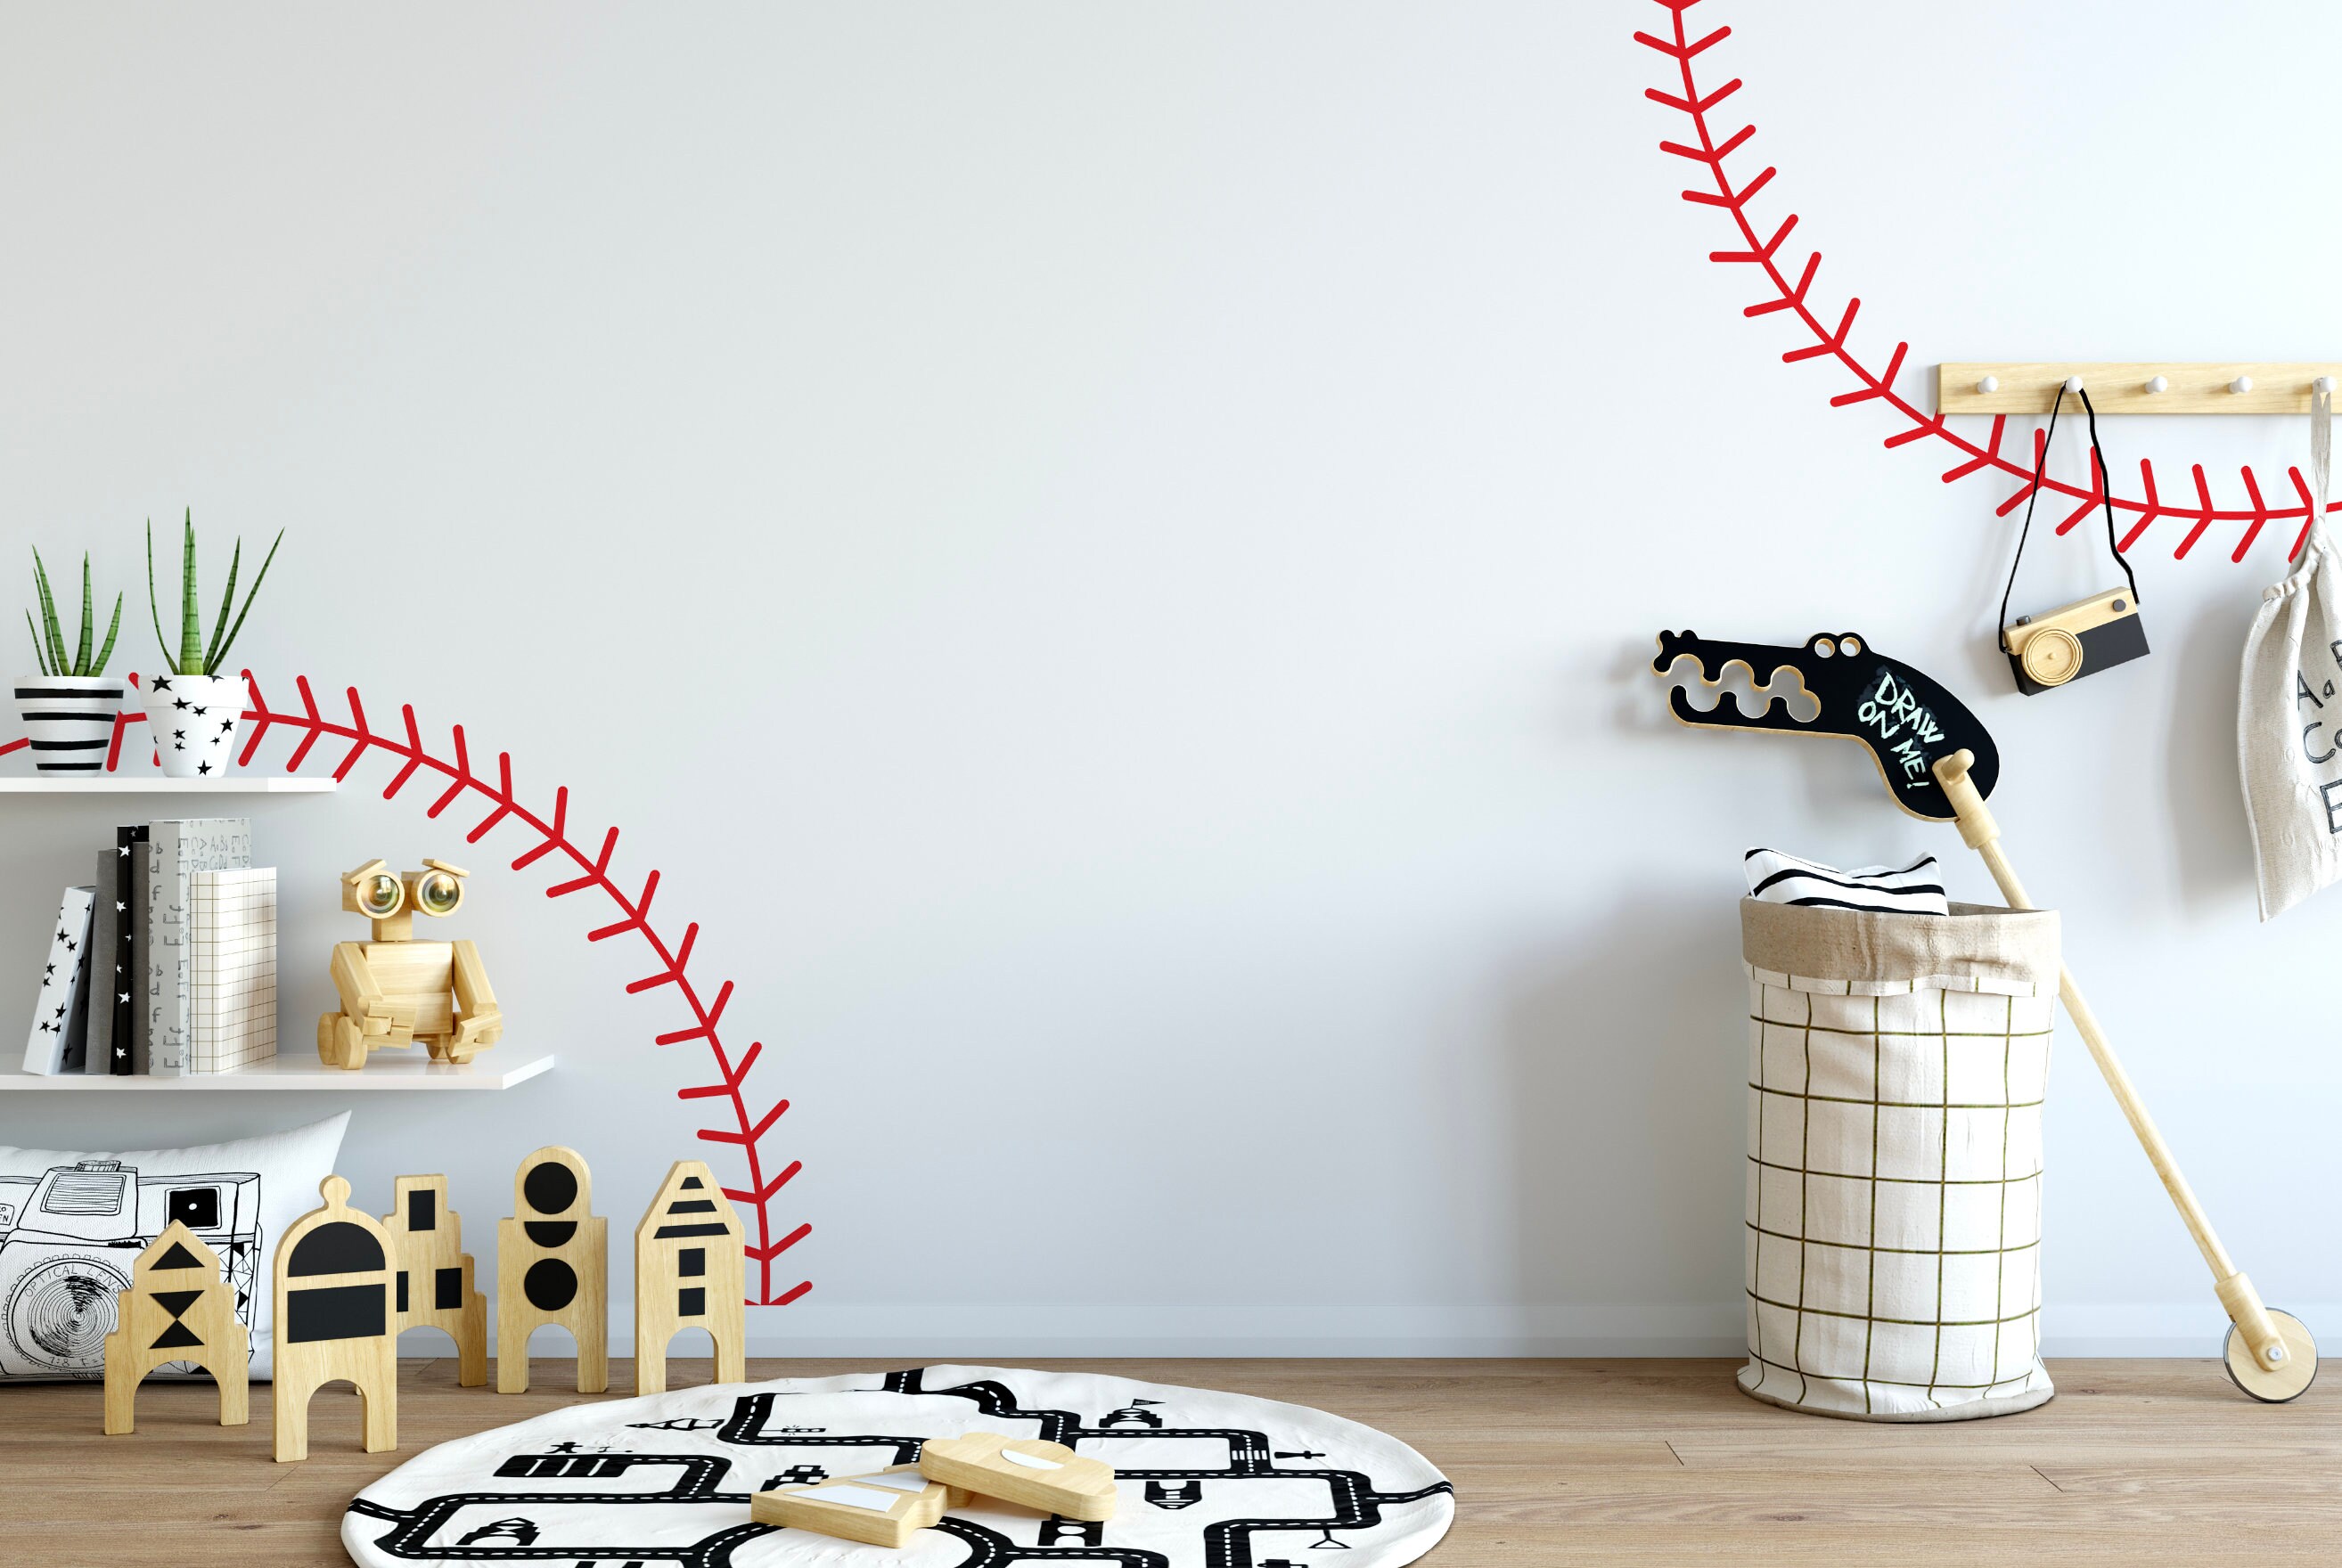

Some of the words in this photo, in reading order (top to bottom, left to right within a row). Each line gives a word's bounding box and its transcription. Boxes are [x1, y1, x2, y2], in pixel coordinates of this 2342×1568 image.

[1874, 672, 1945, 744] DRAW
[1857, 700, 1901, 739] ON
[1890, 729, 1931, 790] ME!
[25, 1264, 78, 1297] OPTICAL
[86, 1266, 124, 1294] LENS
